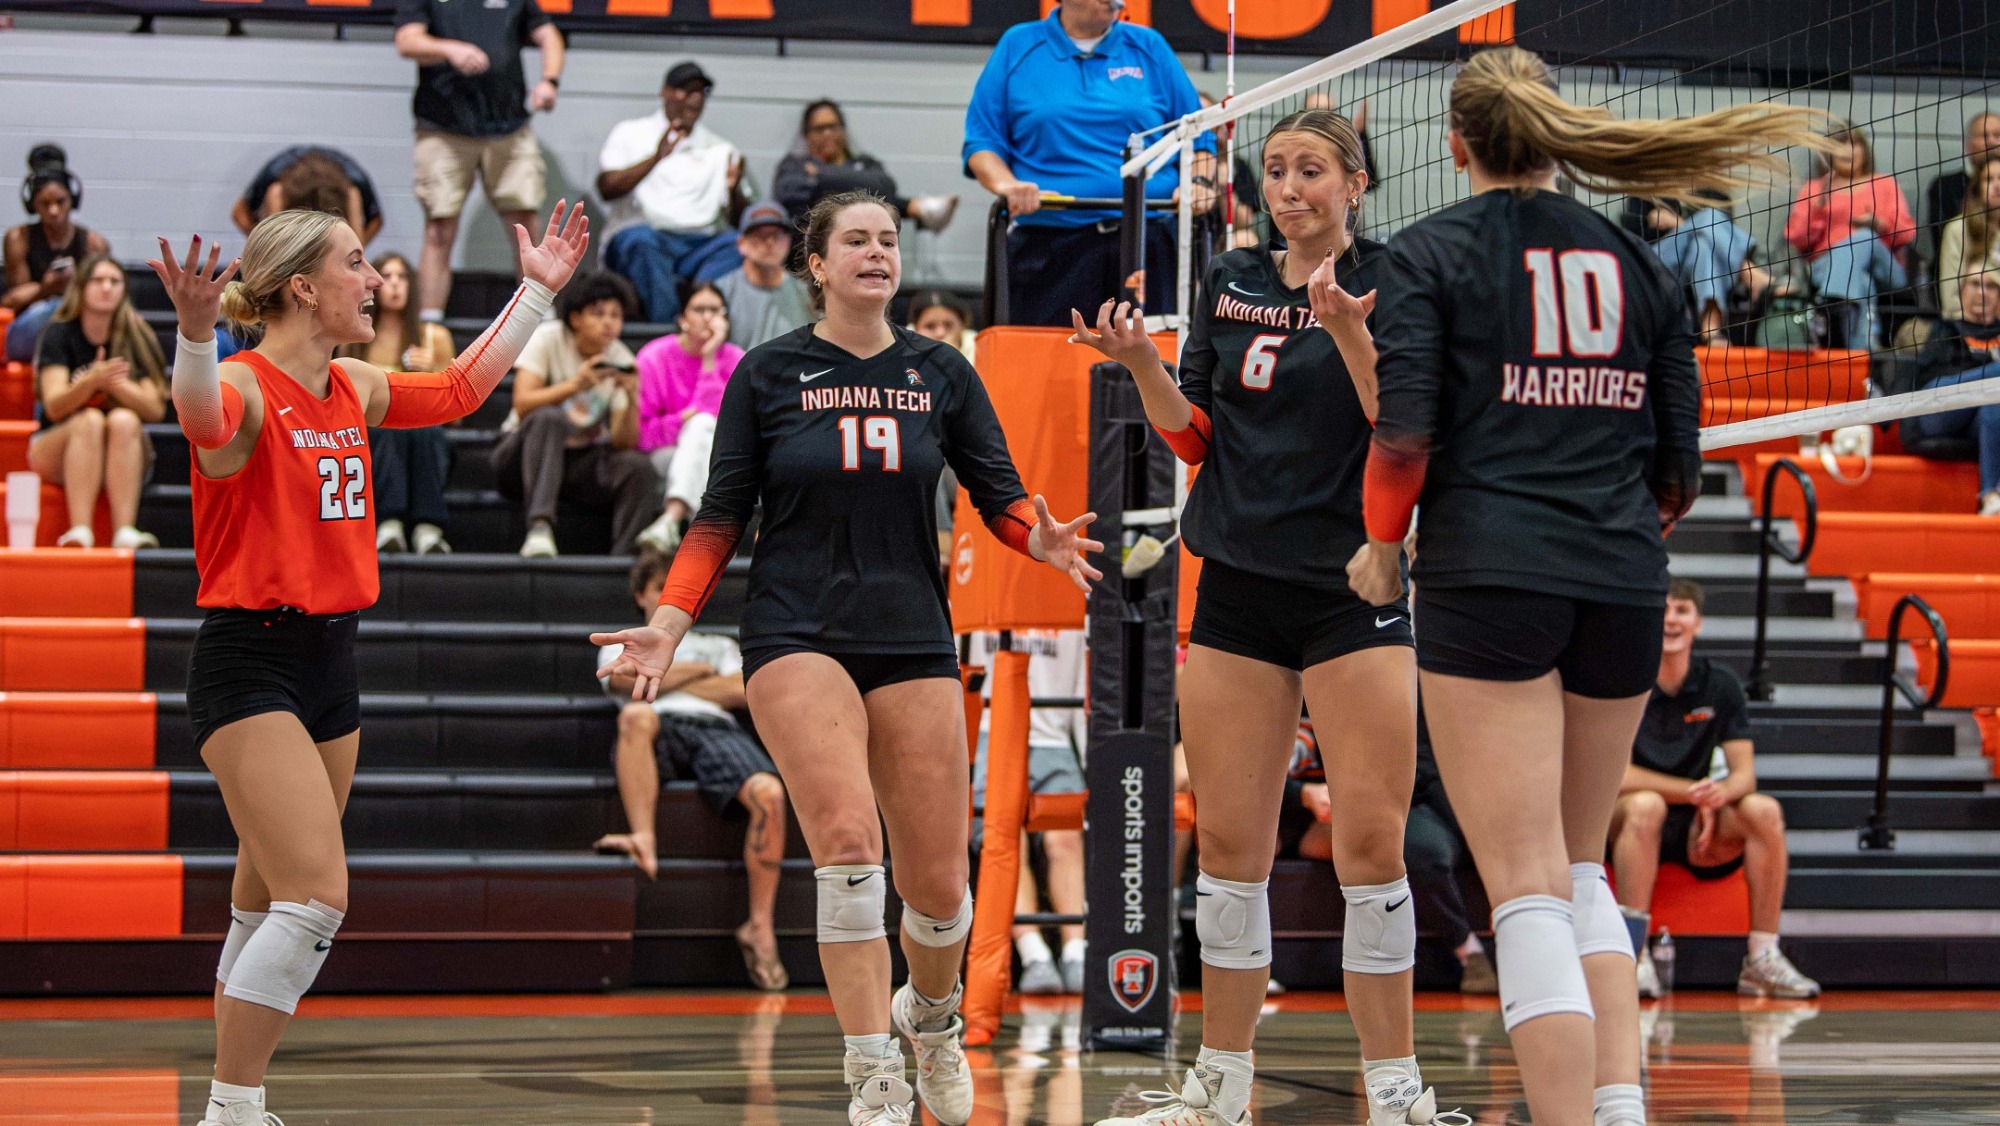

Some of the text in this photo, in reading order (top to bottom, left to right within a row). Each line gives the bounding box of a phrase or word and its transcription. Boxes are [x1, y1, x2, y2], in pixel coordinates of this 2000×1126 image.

[1214, 293, 1323, 330] INDIANA TE
[1523, 247, 1625, 358] 10
[1239, 332, 1289, 392] 6
[1501, 362, 1647, 410] WARRIORS
[800, 385, 932, 413] INDIANA TECH
[837, 414, 901, 473] 19
[317, 455, 367, 522] 22
[1120, 766, 1146, 934] sports imports
